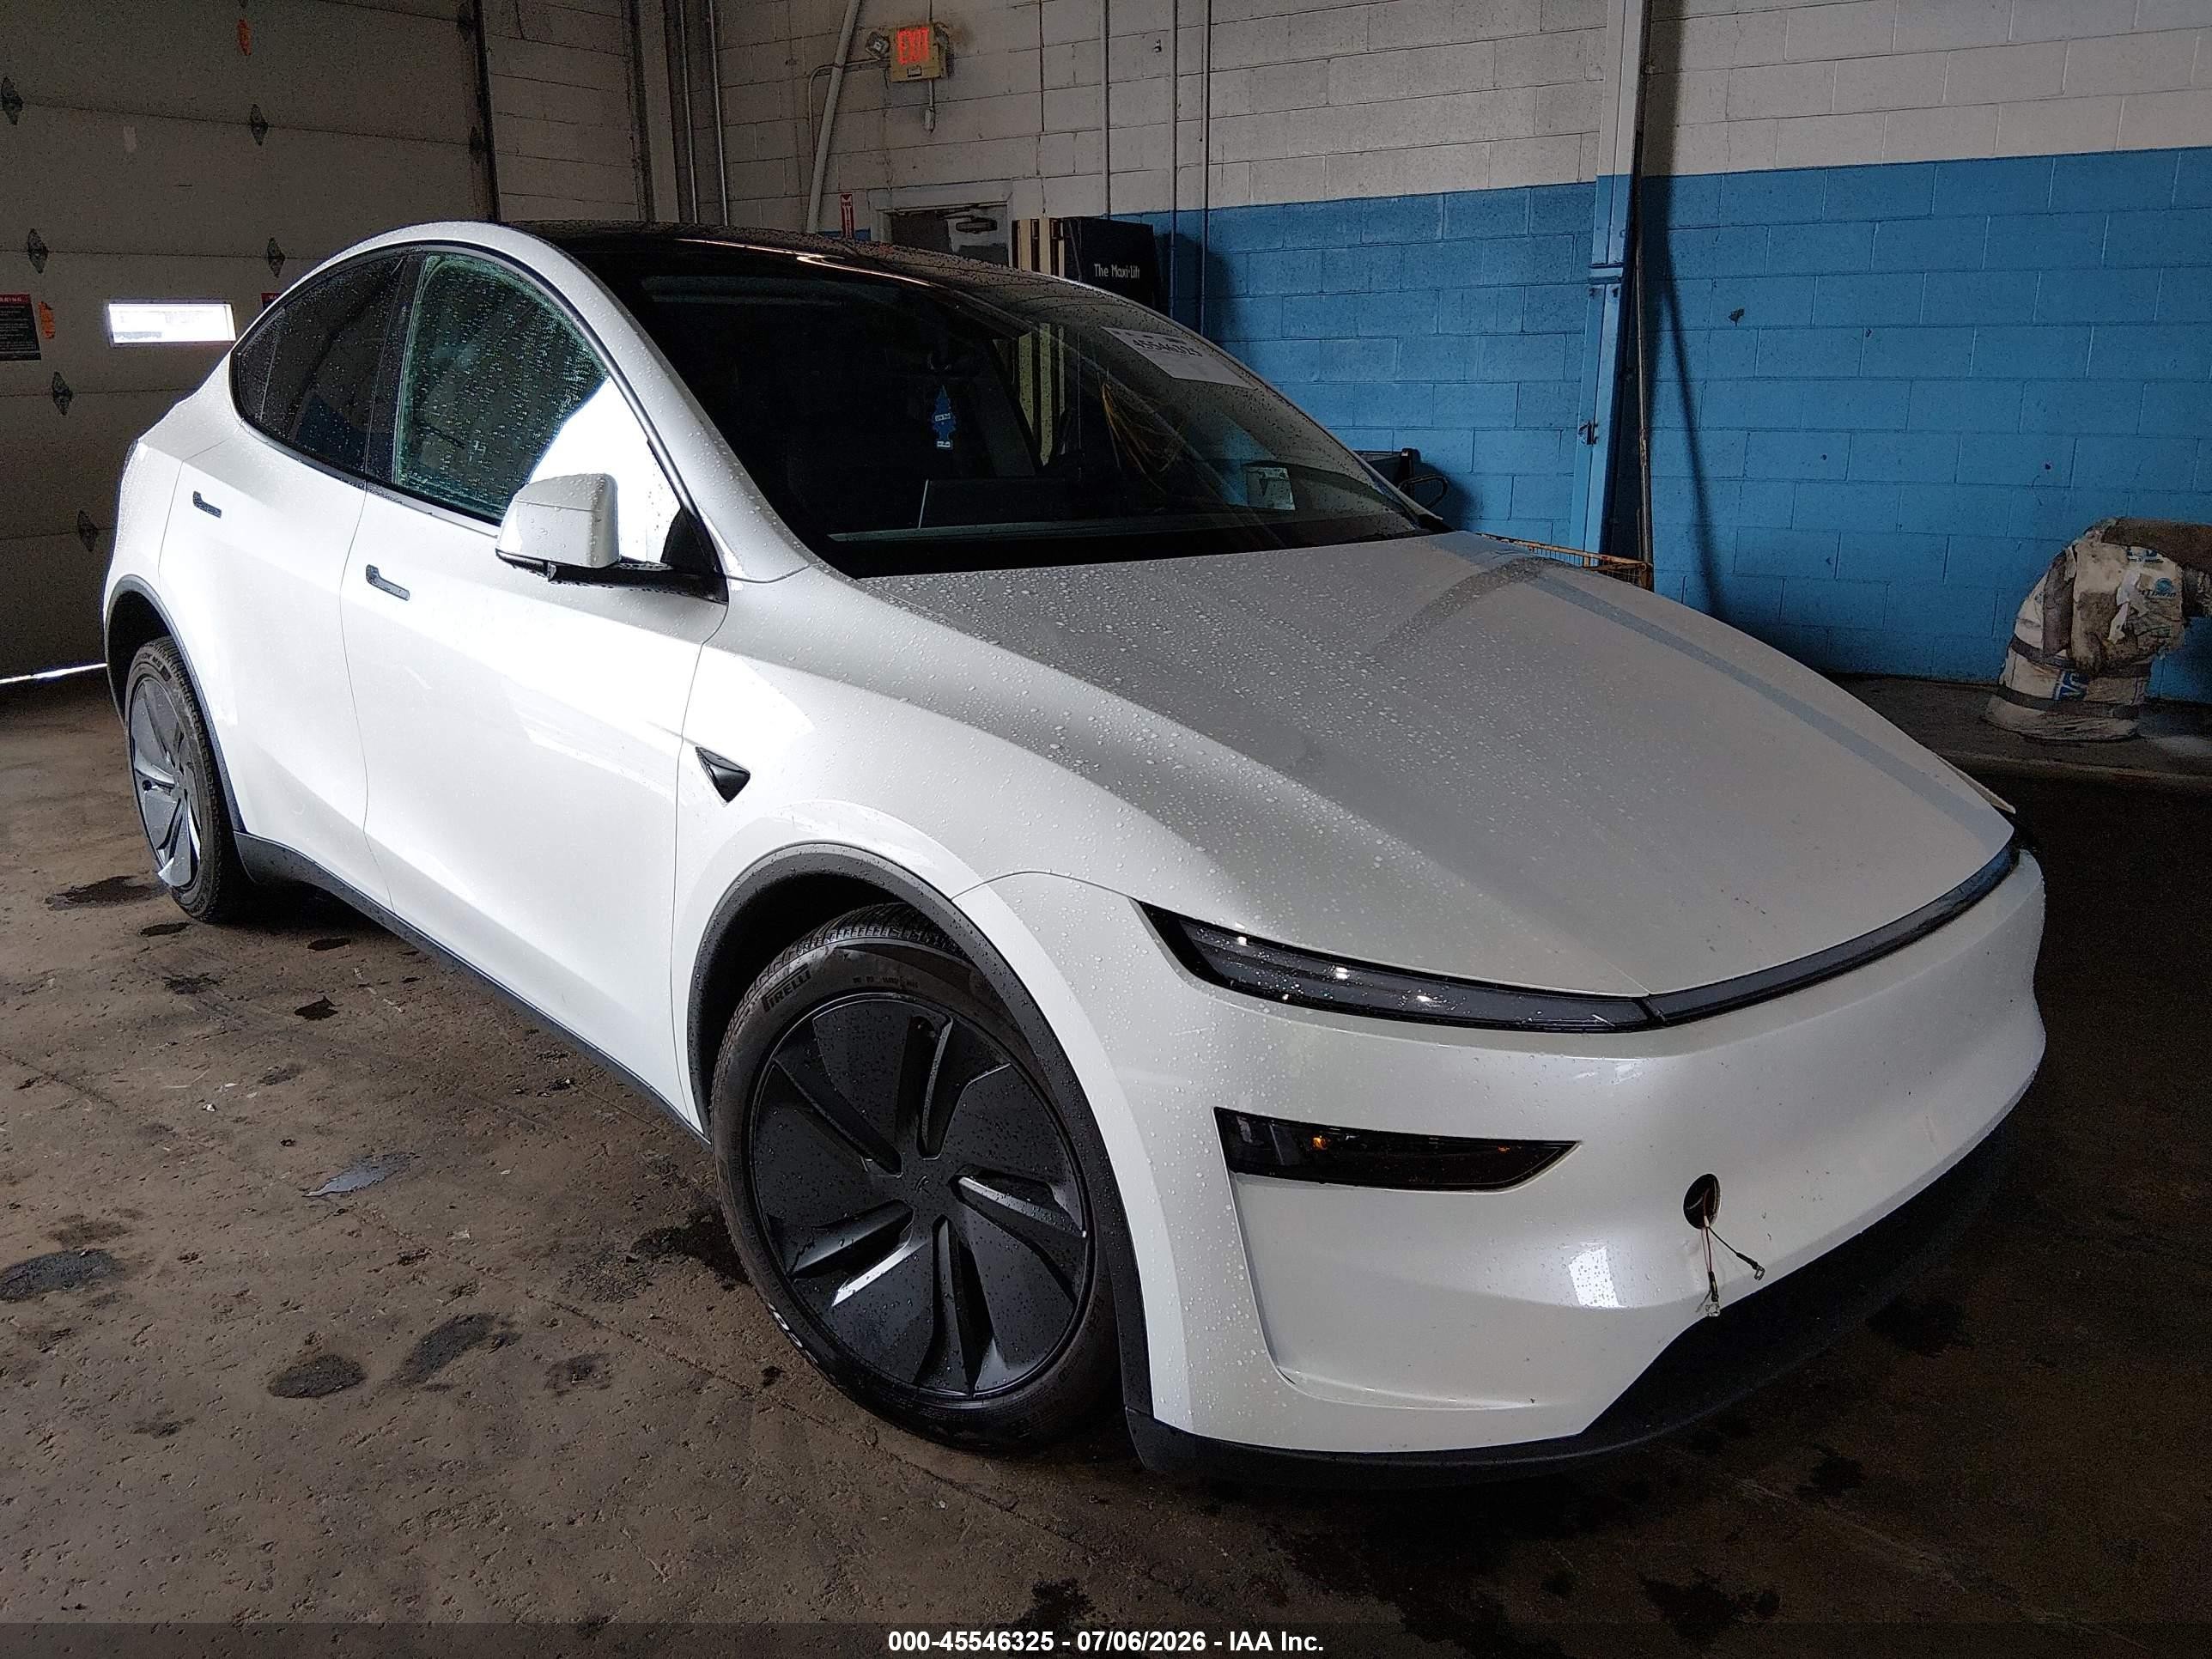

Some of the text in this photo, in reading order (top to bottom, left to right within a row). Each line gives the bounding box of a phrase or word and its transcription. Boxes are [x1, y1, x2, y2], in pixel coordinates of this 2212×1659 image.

[896, 27, 929, 65] EXIT
[1093, 263, 1109, 277] The
[762, 963, 811, 1012] PIRELLI
